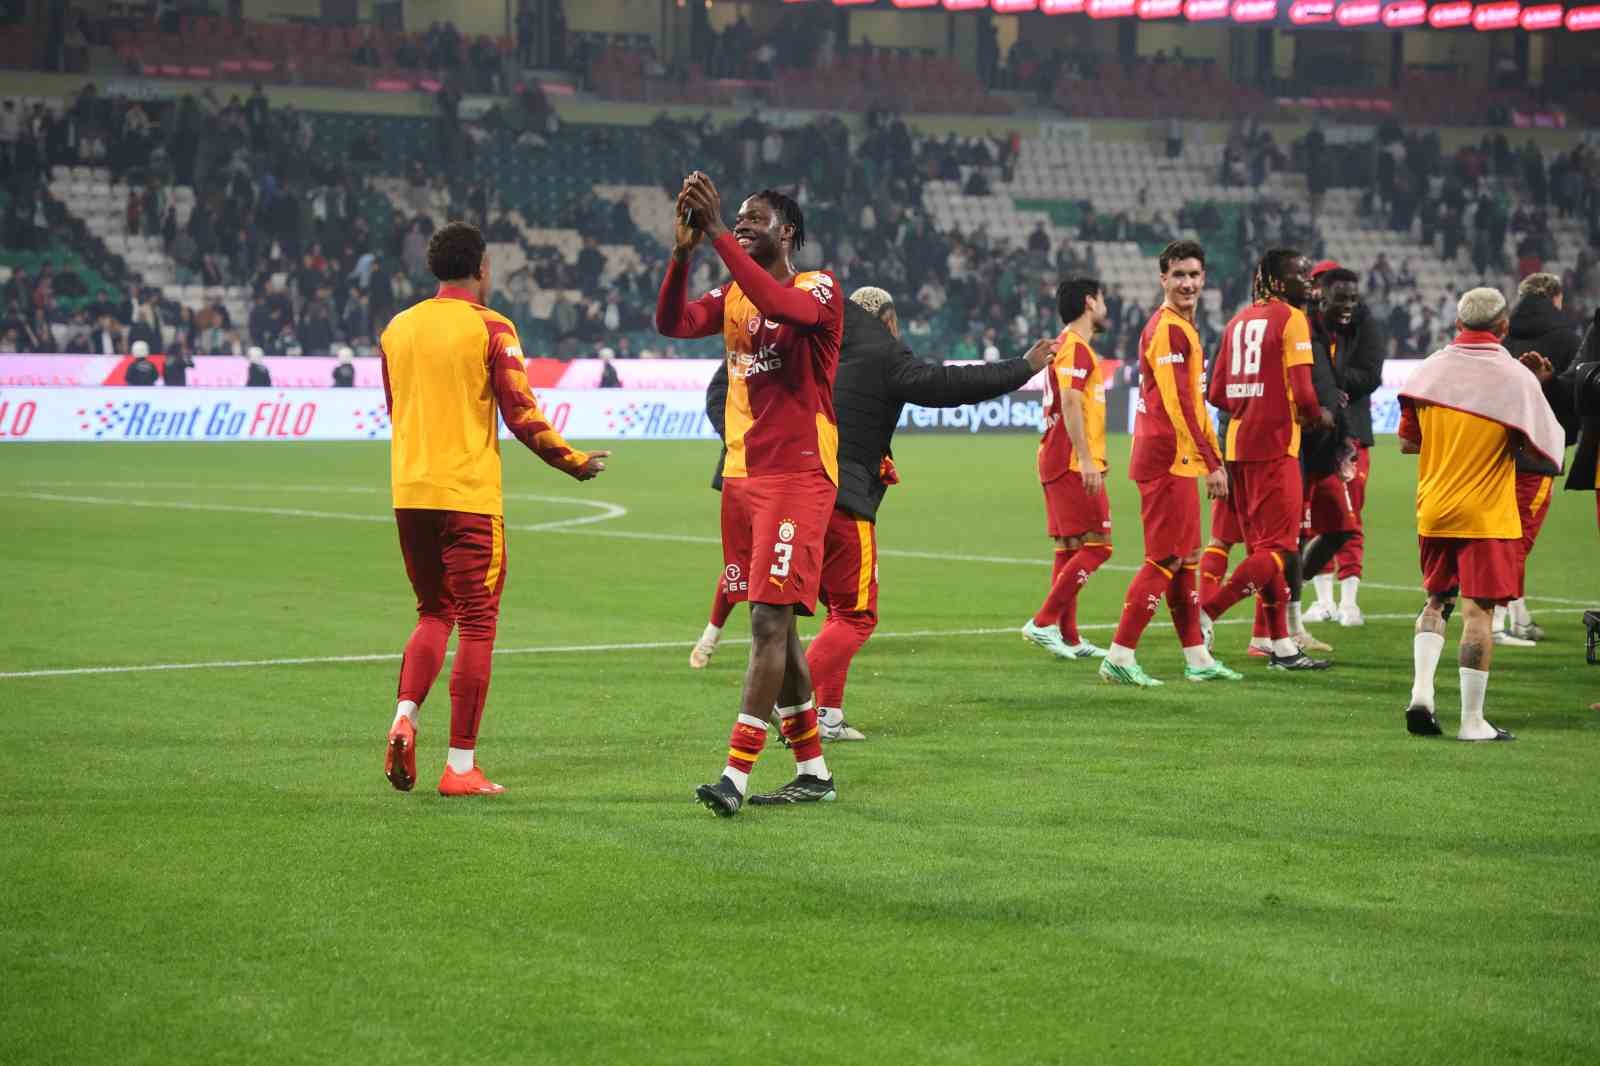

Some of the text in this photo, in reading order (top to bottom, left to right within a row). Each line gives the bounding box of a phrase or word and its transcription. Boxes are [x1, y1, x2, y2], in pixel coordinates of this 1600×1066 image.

[1231, 319, 1268, 375] 18
[0, 399, 37, 436] LO
[125, 391, 317, 436] Rent Go FİLO
[896, 394, 1010, 433] rendyol
[769, 542, 793, 577] 3
